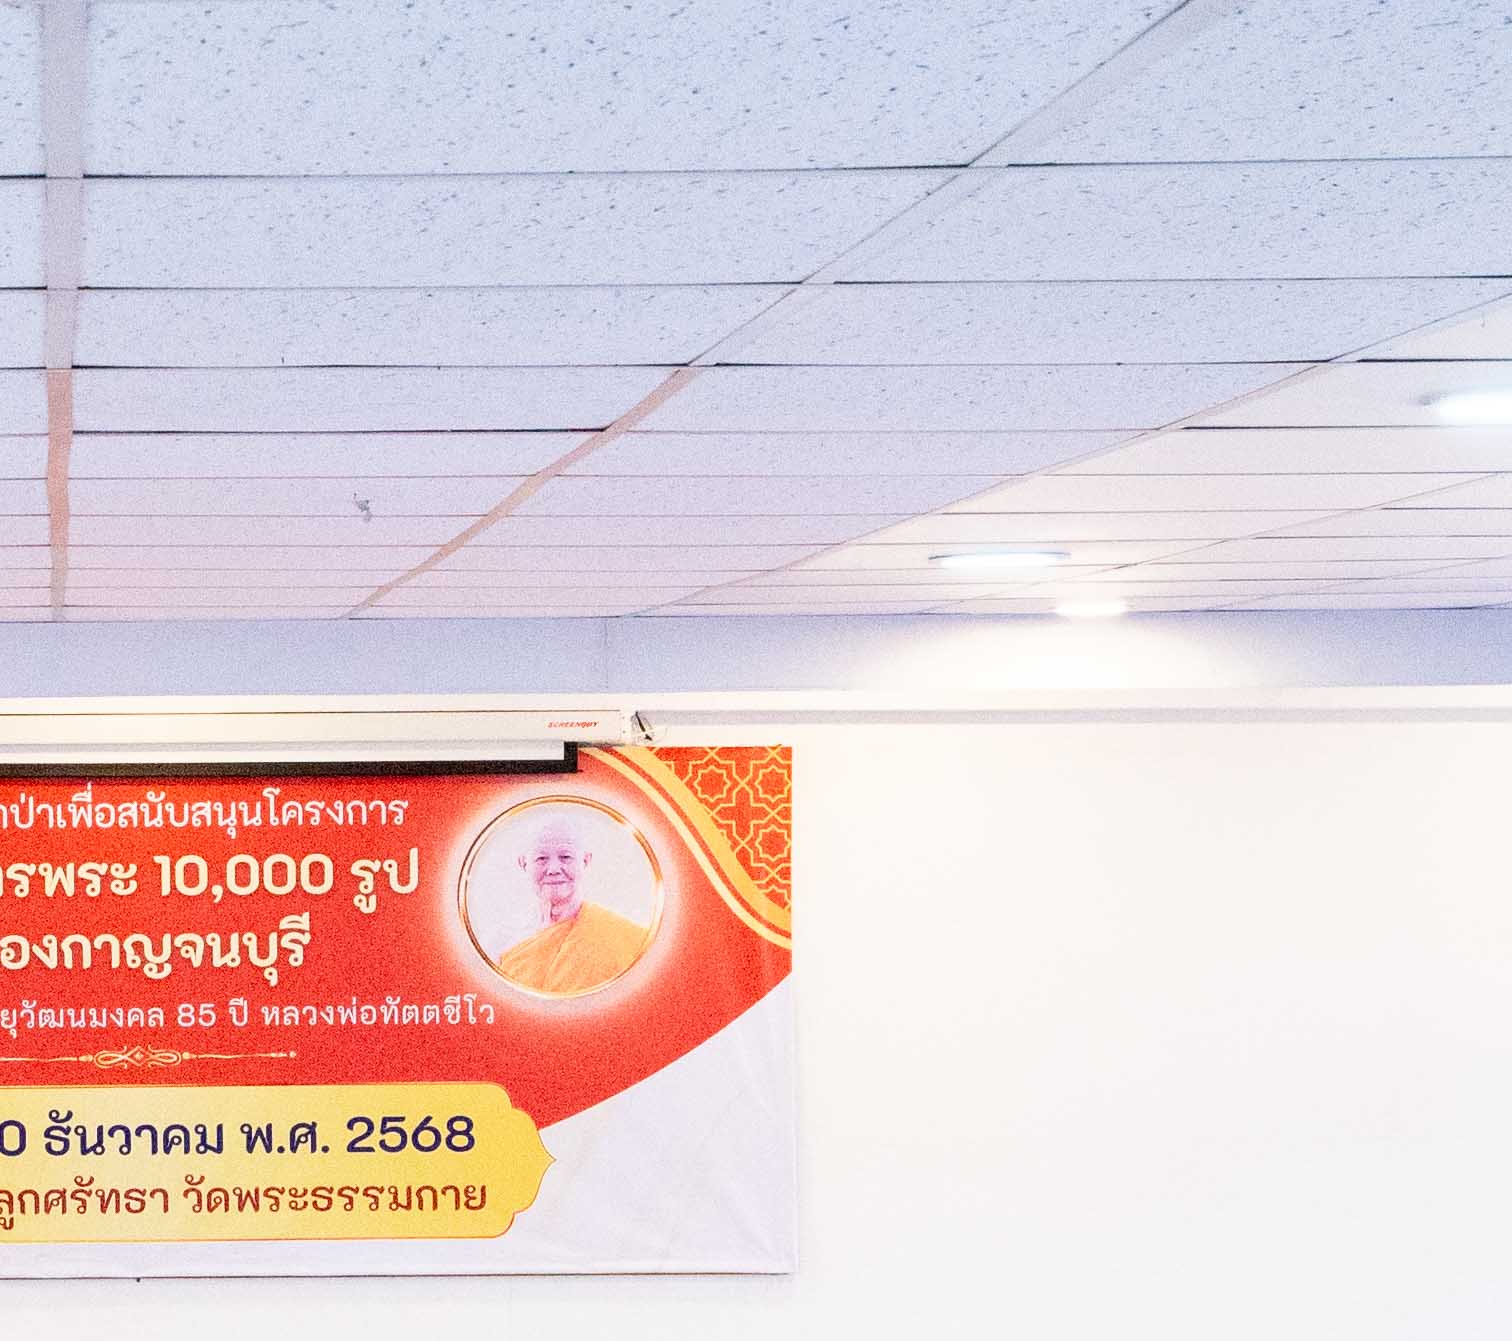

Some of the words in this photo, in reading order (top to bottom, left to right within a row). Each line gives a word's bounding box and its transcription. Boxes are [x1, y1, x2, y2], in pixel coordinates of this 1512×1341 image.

[153, 852, 336, 903] 10,000
[350, 847, 420, 914] รูป
[176, 1003, 217, 1028] 85
[228, 997, 249, 1027] ปี
[261, 992, 496, 1027] หลวงพ่อทัตตชีโว
[43, 1109, 225, 1157] ธันวาคม
[239, 1120, 331, 1155] พ.ศ.
[345, 1115, 476, 1154] 2568
[182, 1173, 488, 1214] วัดพระธรรมกาย
